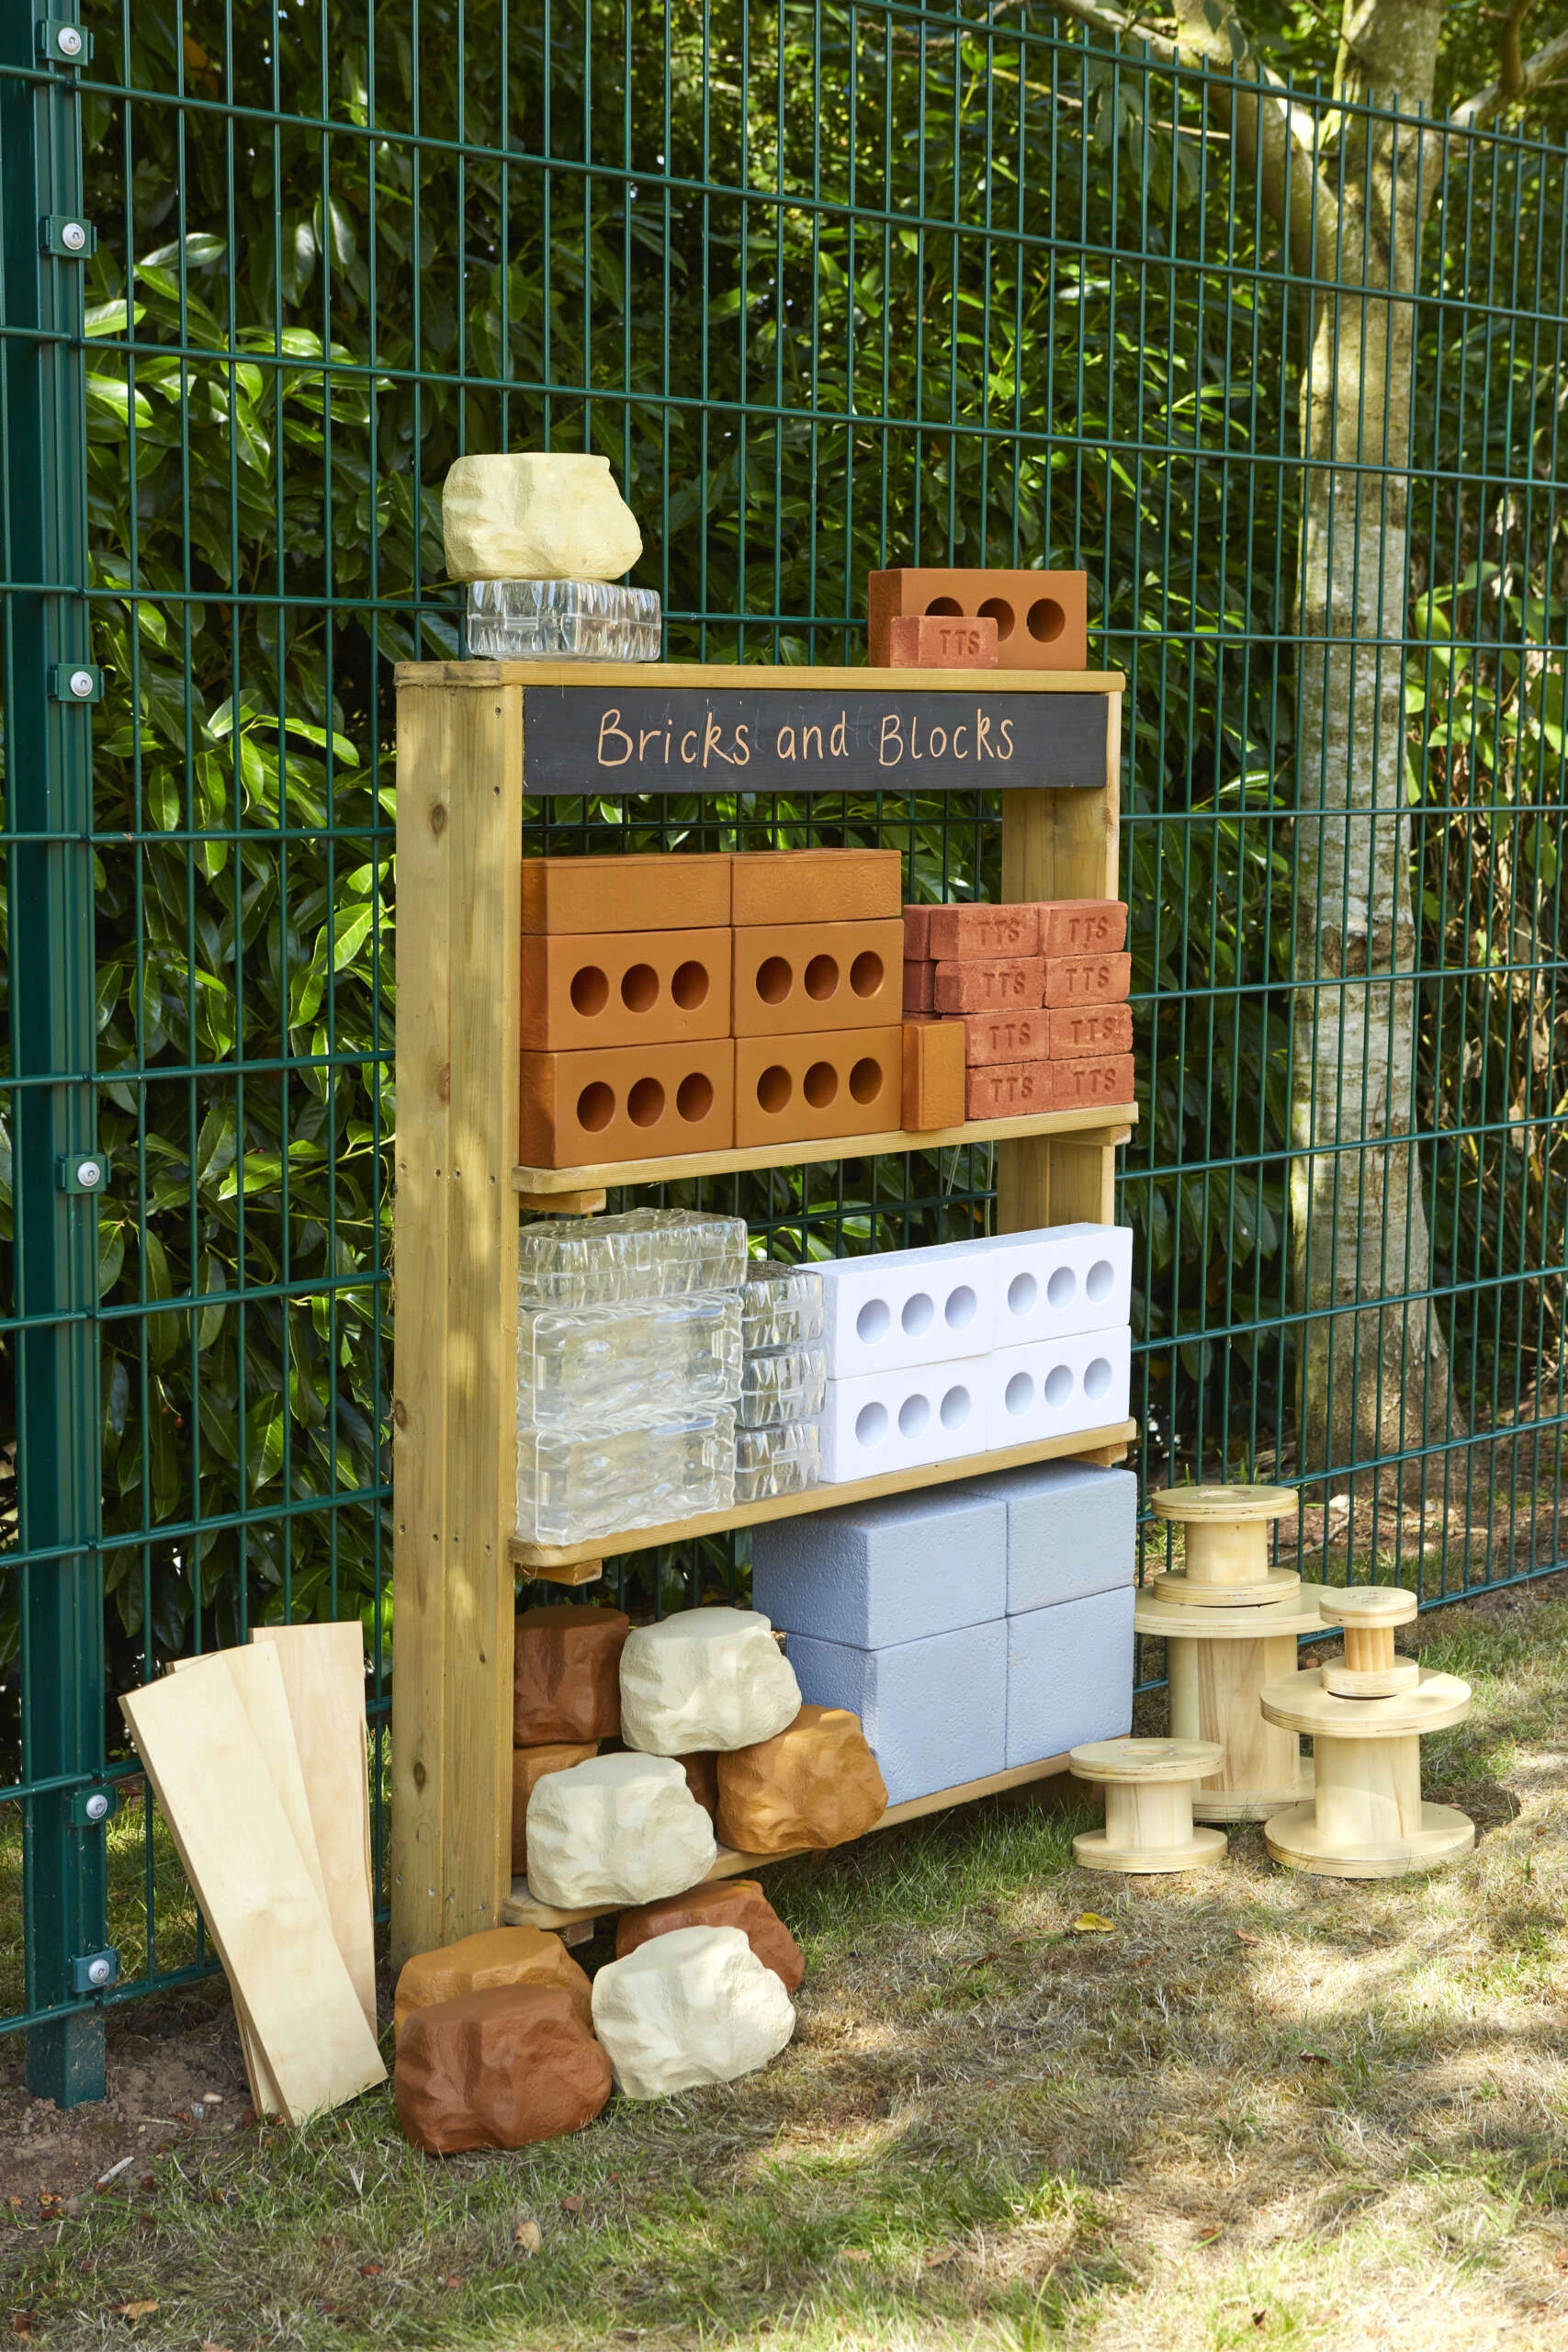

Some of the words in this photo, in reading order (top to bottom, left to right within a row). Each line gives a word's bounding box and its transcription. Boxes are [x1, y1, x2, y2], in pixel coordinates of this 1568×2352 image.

[939, 629, 981, 655] TTS
[596, 708, 750, 768] Bricks
[776, 709, 850, 763] and
[878, 707, 1015, 767] Blocks
[978, 921, 1021, 945] TTS
[1069, 916, 1109, 944] TTS
[983, 971, 1026, 998] TTS
[1066, 966, 1111, 993] TTS
[989, 1023, 1031, 1050] TTS
[1071, 1017, 1117, 1046] TTS
[991, 1077, 1033, 1102] TTS
[1073, 1069, 1117, 1095] TTS
